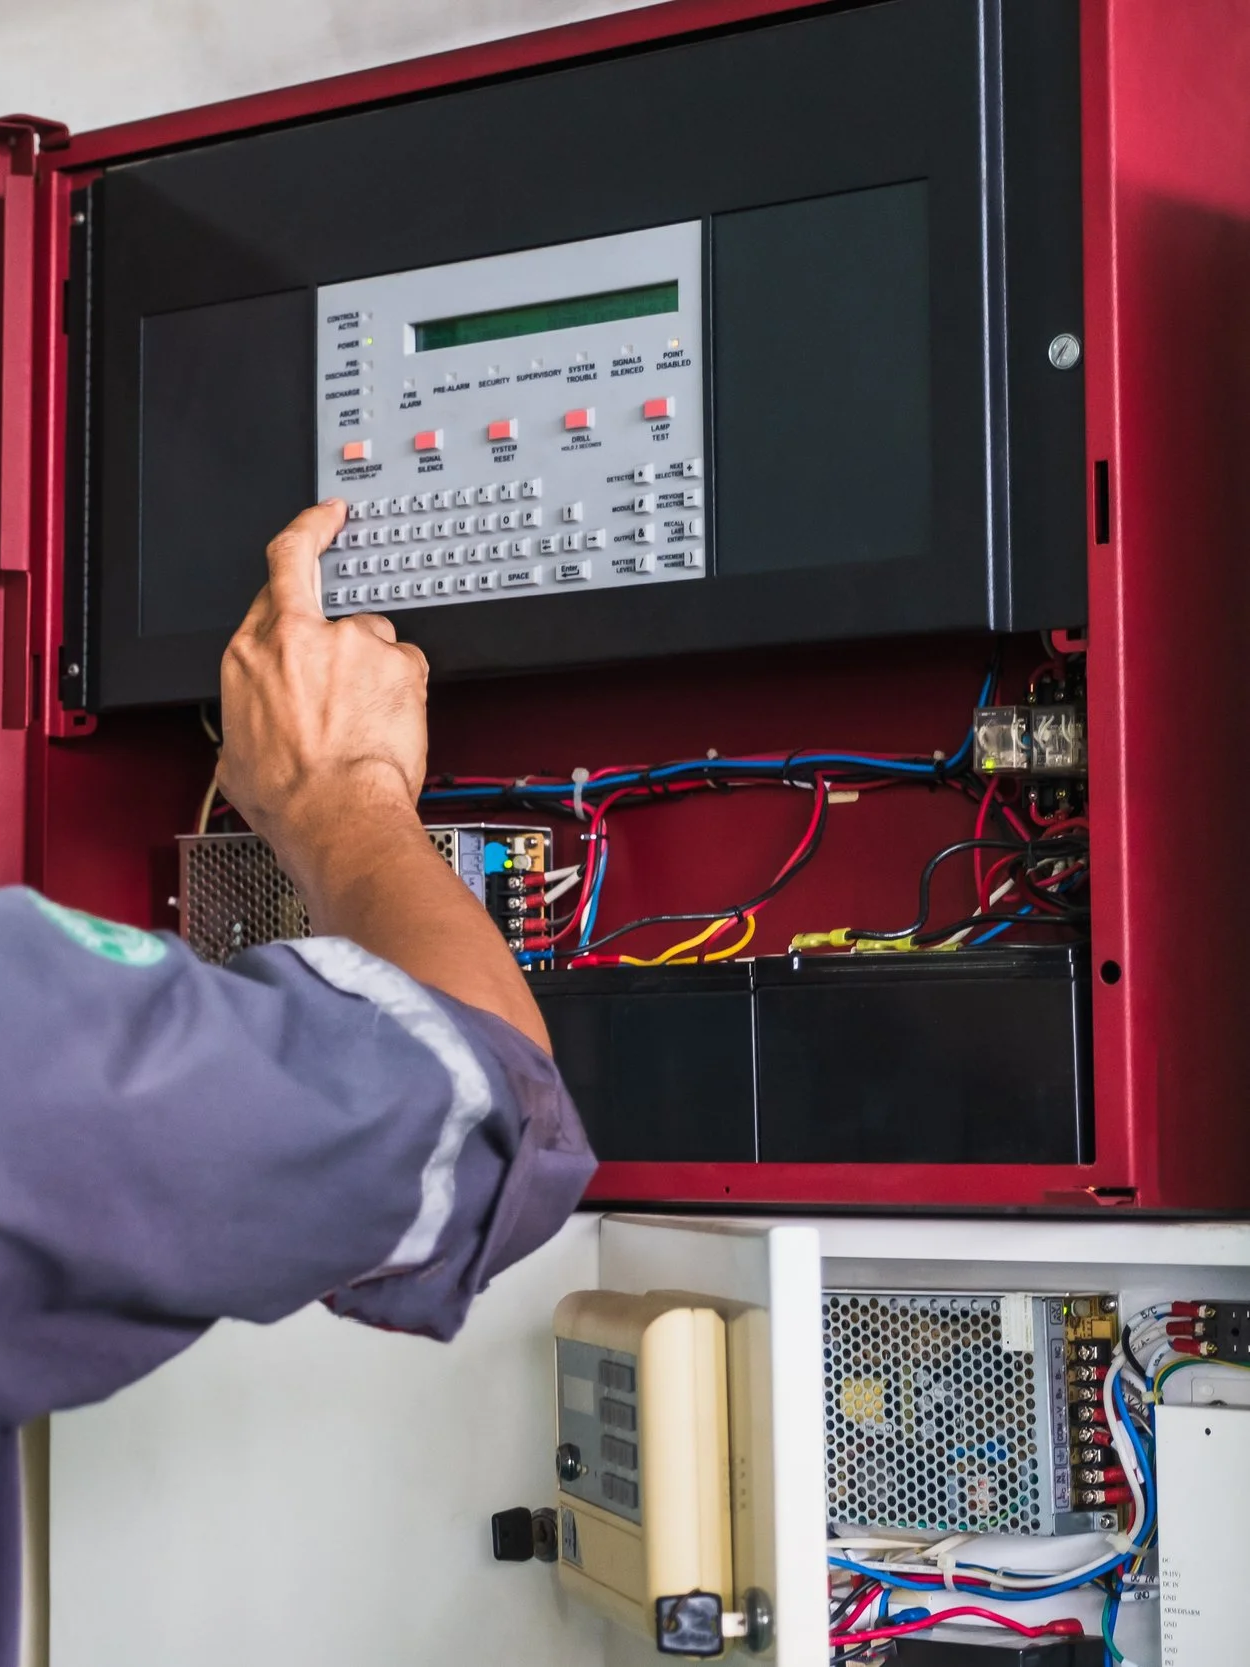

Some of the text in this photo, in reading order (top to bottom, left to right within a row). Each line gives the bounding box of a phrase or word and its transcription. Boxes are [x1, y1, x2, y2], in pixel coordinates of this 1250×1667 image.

[327, 312, 359, 323] CONTROLS
[338, 321, 359, 330] ACTIVE
[338, 340, 359, 350] POWER
[663, 350, 684, 359] POINT
[613, 356, 642, 367] SIGNALS
[656, 359, 691, 370] DISABLED
[569, 363, 595, 374] SYSTEM
[610, 366, 644, 377] SILENCED
[325, 369, 359, 380] DISCHARGE
[517, 369, 562, 382] SUPERVISORY
[567, 372, 597, 383] TROUBLE
[479, 377, 510, 388] SECURITY
[433, 383, 470, 394] PRE-ALARM
[325, 389, 360, 400] DISCHARGE
[403, 391, 417, 399] FIRE
[400, 400, 421, 410] ALARM
[339, 409, 359, 418] ABORT
[339, 418, 359, 427] ACTIVE
[651, 424, 670, 432] LAMP
[572, 435, 590, 443] DRILL
[652, 433, 669, 441] TEST
[492, 445, 517, 454] SYSTEM
[419, 455, 441, 463] SIGNAL
[494, 454, 514, 463] RESET
[336, 464, 382, 476] ACKNOWLEDGE
[418, 464, 443, 473] SILENCE
[374, 532, 378, 540] E
[460, 522, 465, 530] U
[503, 516, 509, 524] O
[527, 513, 531, 521] P
[638, 528, 644, 537] &
[426, 554, 432, 562] G
[471, 549, 475, 557] J
[493, 546, 498, 554] K
[352, 590, 357, 598] Z
[374, 588, 378, 596] X
[508, 572, 529, 581] SPACE
[1145, 1575, 1155, 1583] IN
[1134, 1590, 1149, 1600] GND
